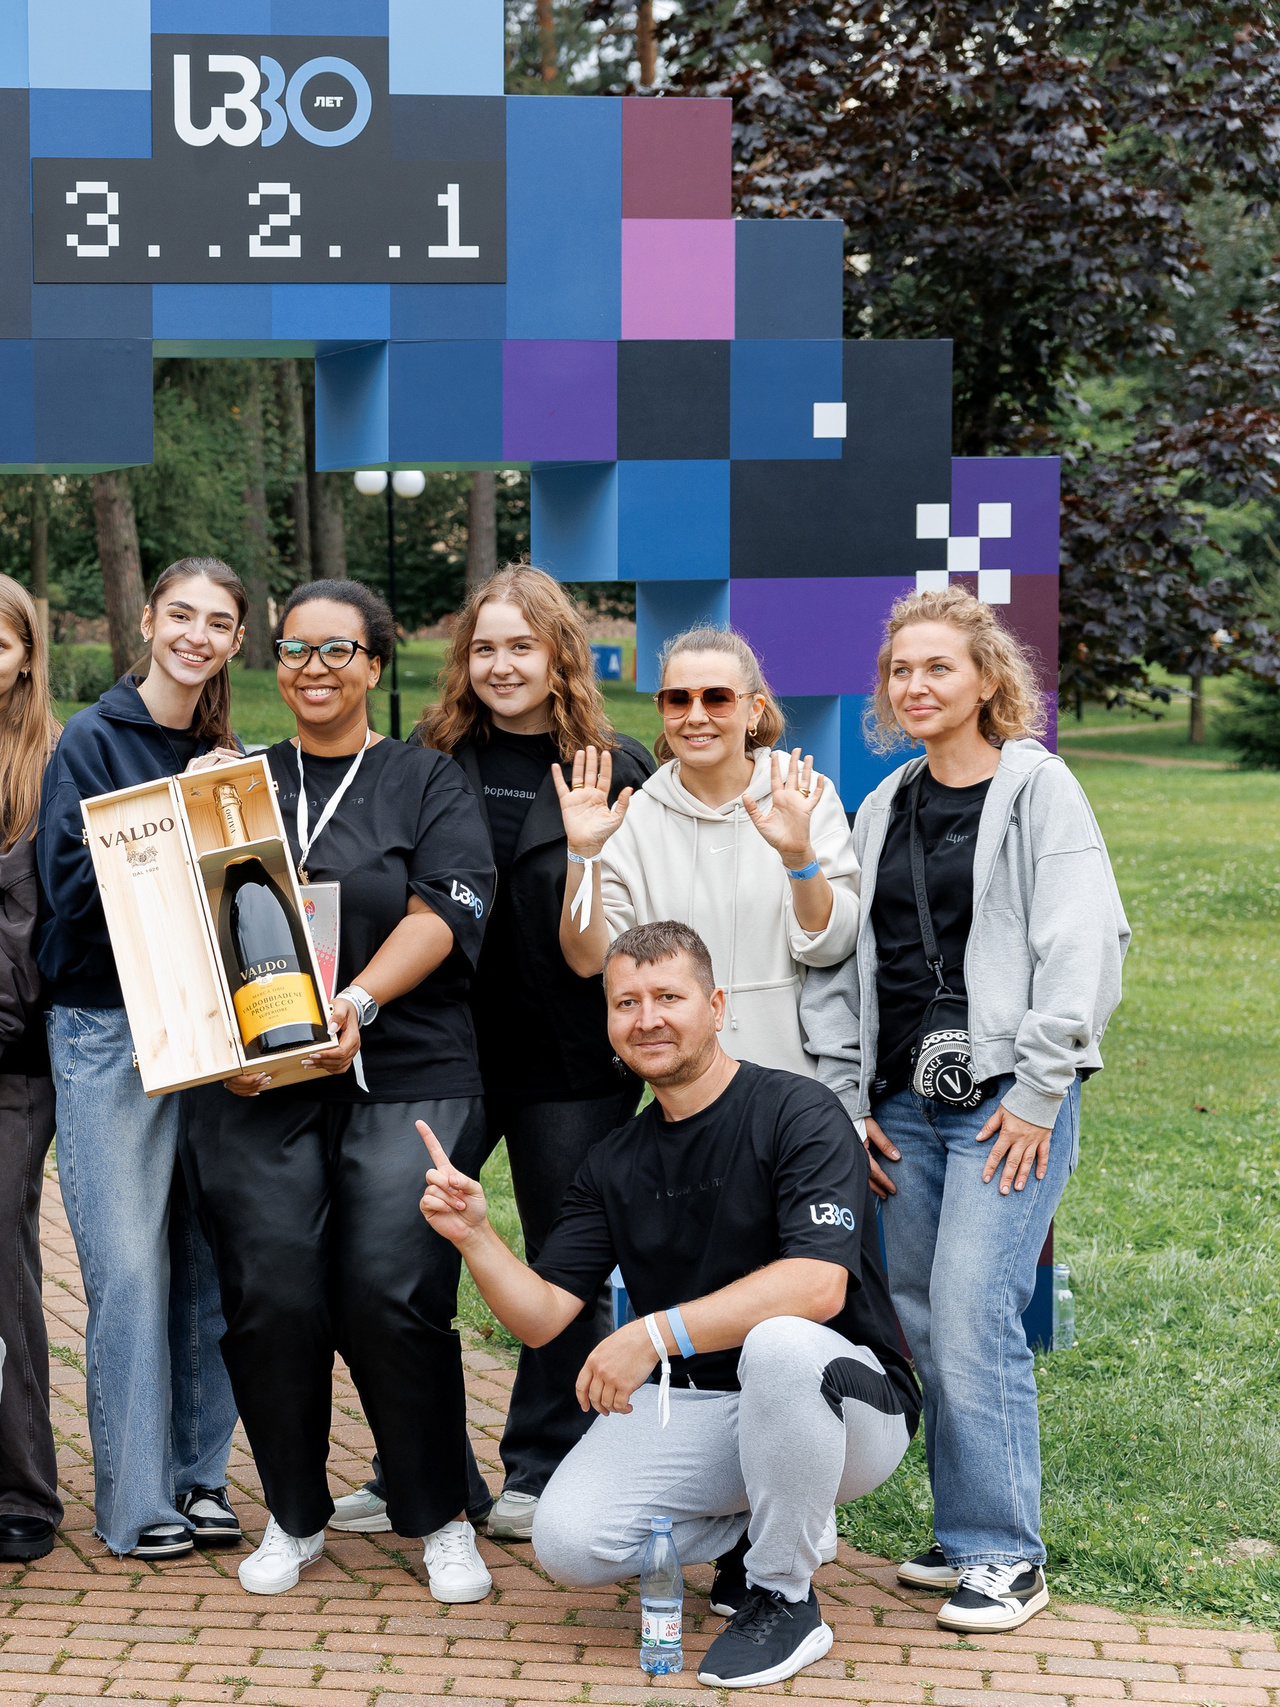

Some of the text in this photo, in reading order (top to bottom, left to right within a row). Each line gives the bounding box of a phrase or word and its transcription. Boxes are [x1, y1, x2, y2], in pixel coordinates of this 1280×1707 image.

[313, 95, 344, 108] ЛЕТ
[99, 817, 175, 849] VALDO
[920, 912, 936, 951] JEANS
[240, 959, 287, 981] VALDO
[242, 991, 303, 1014] VALDOBBIADENE
[251, 999, 294, 1016] PROSECCO
[923, 1056, 943, 1098] VERSACE
[942, 1070, 962, 1094] V
